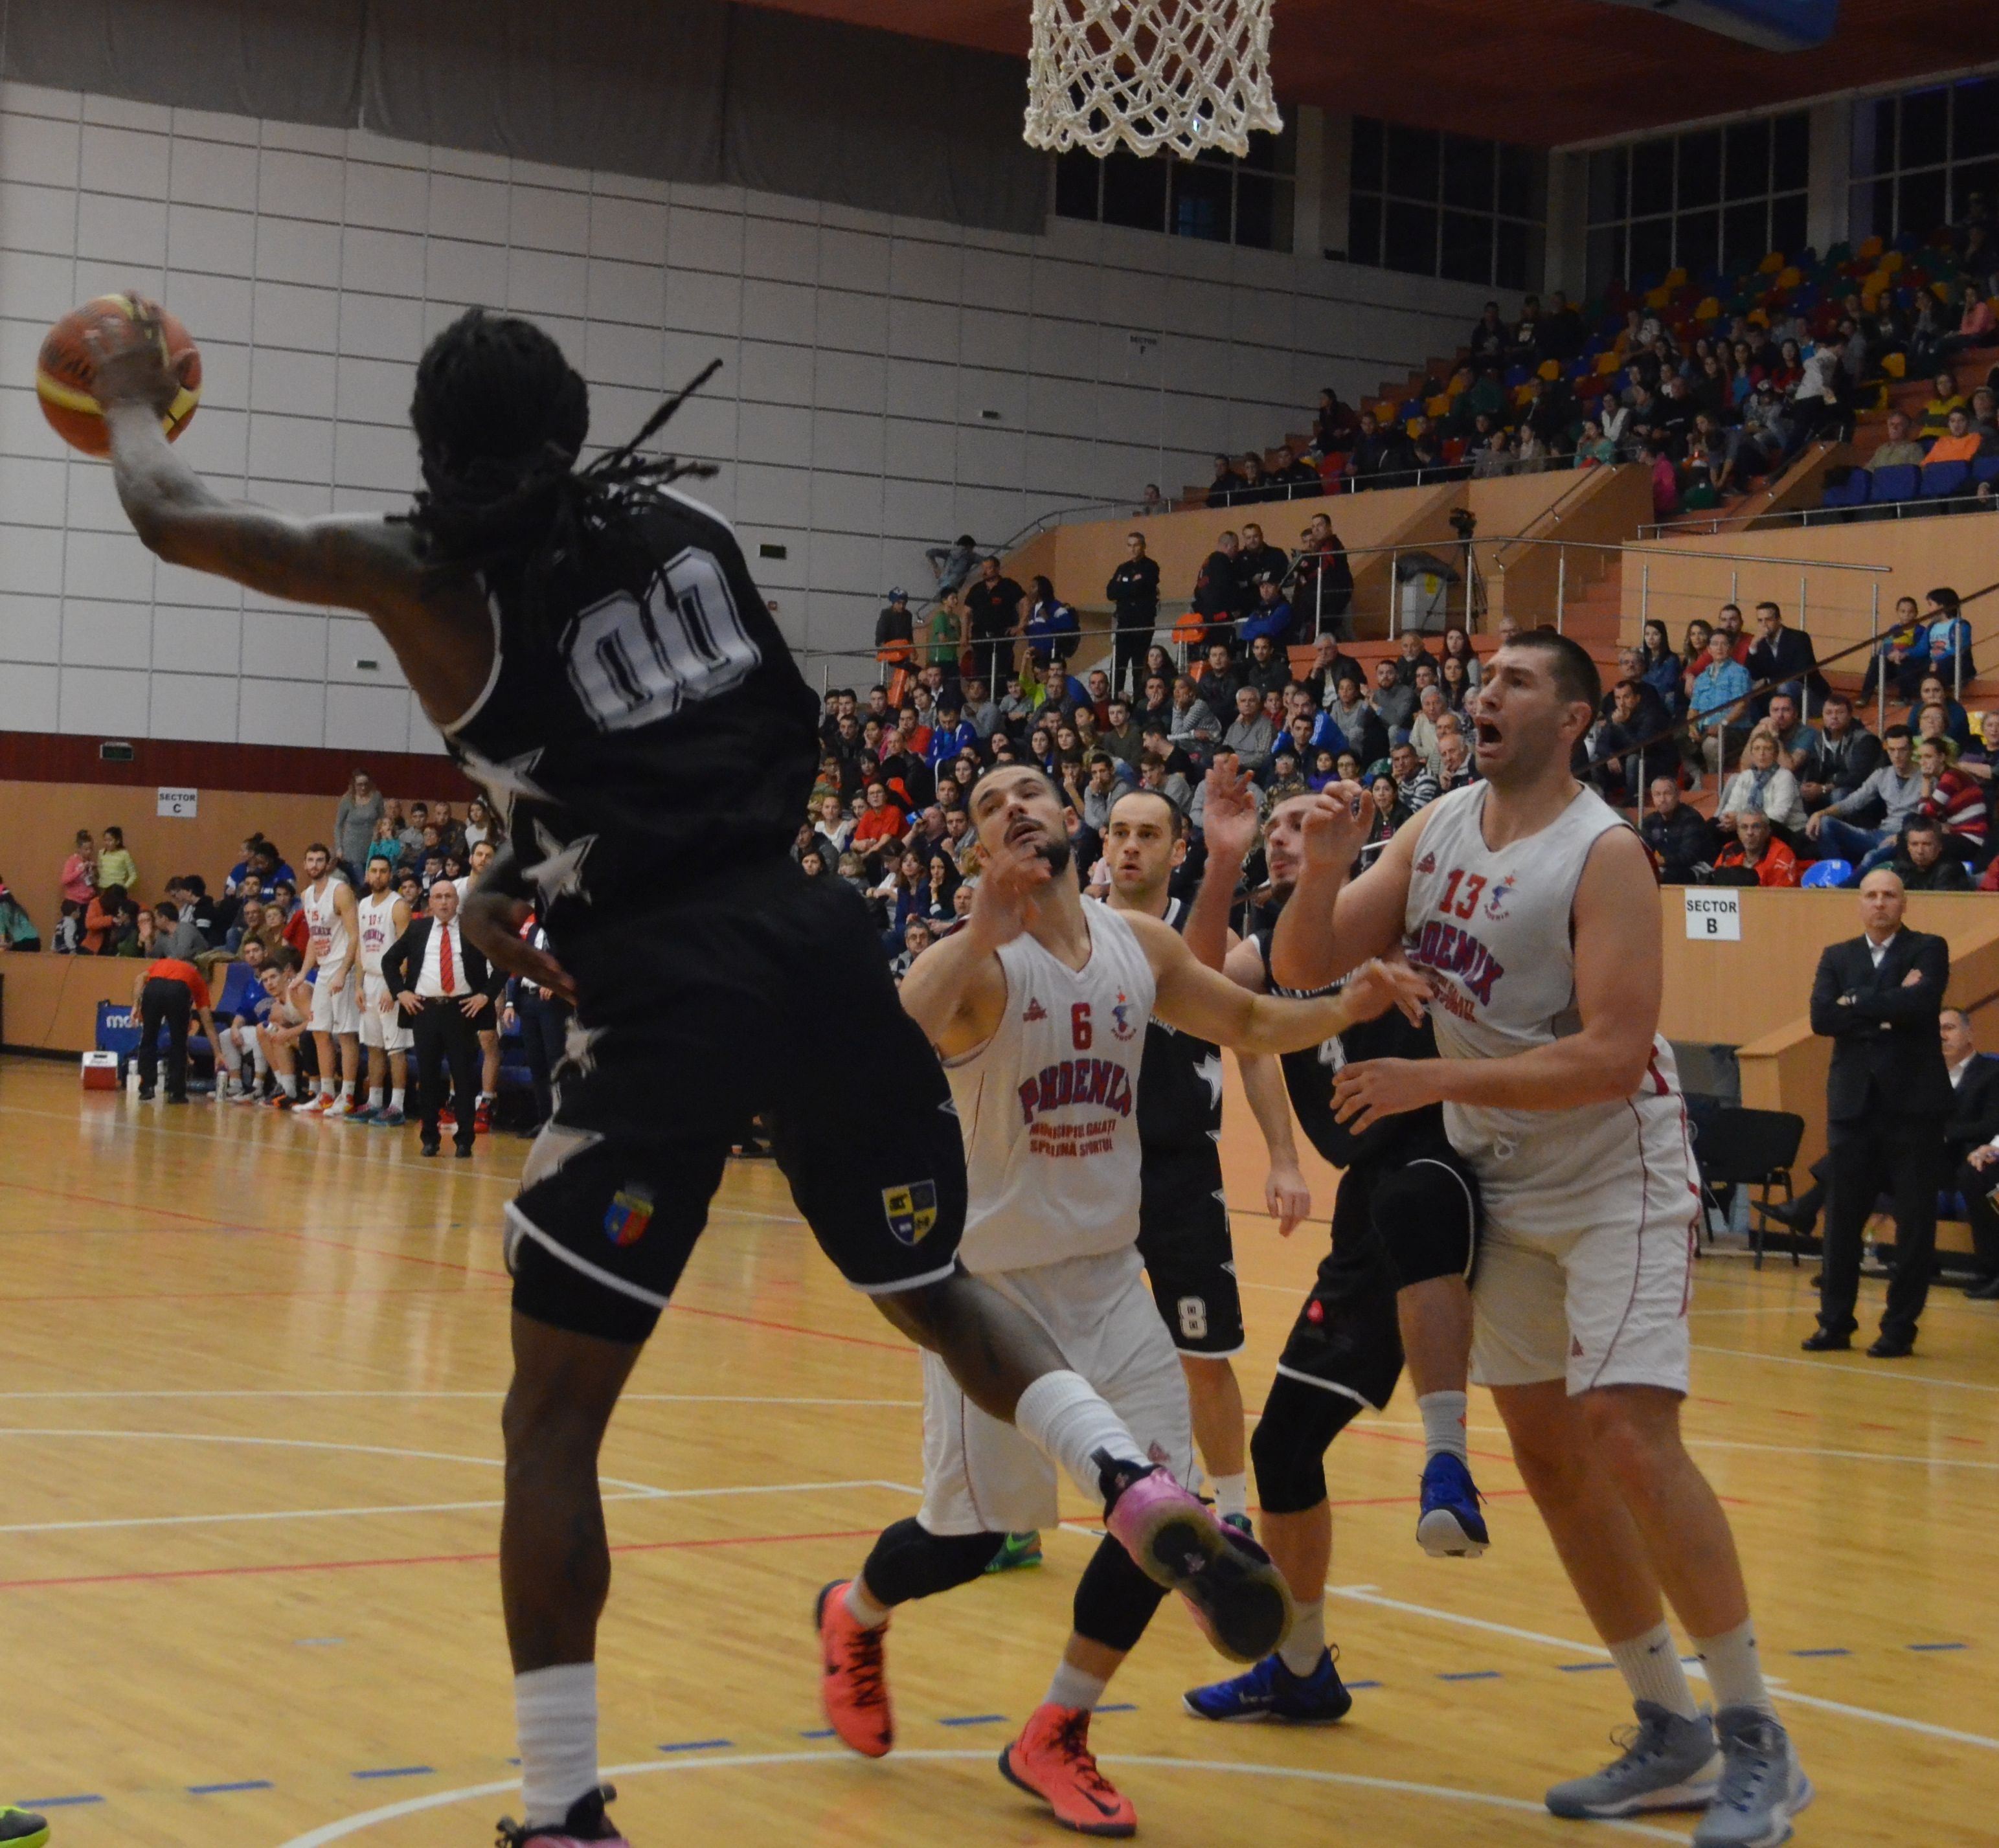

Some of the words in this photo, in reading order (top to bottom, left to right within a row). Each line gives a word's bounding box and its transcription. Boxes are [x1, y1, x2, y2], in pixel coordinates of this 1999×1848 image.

[558, 546, 762, 731] 00
[173, 804, 181, 813] C
[1439, 868, 1487, 920] 13
[1686, 899, 1737, 913] SECTOR
[1707, 918, 1717, 934] B
[1071, 1002, 1092, 1050] 6
[1178, 1296, 1207, 1339] 8
